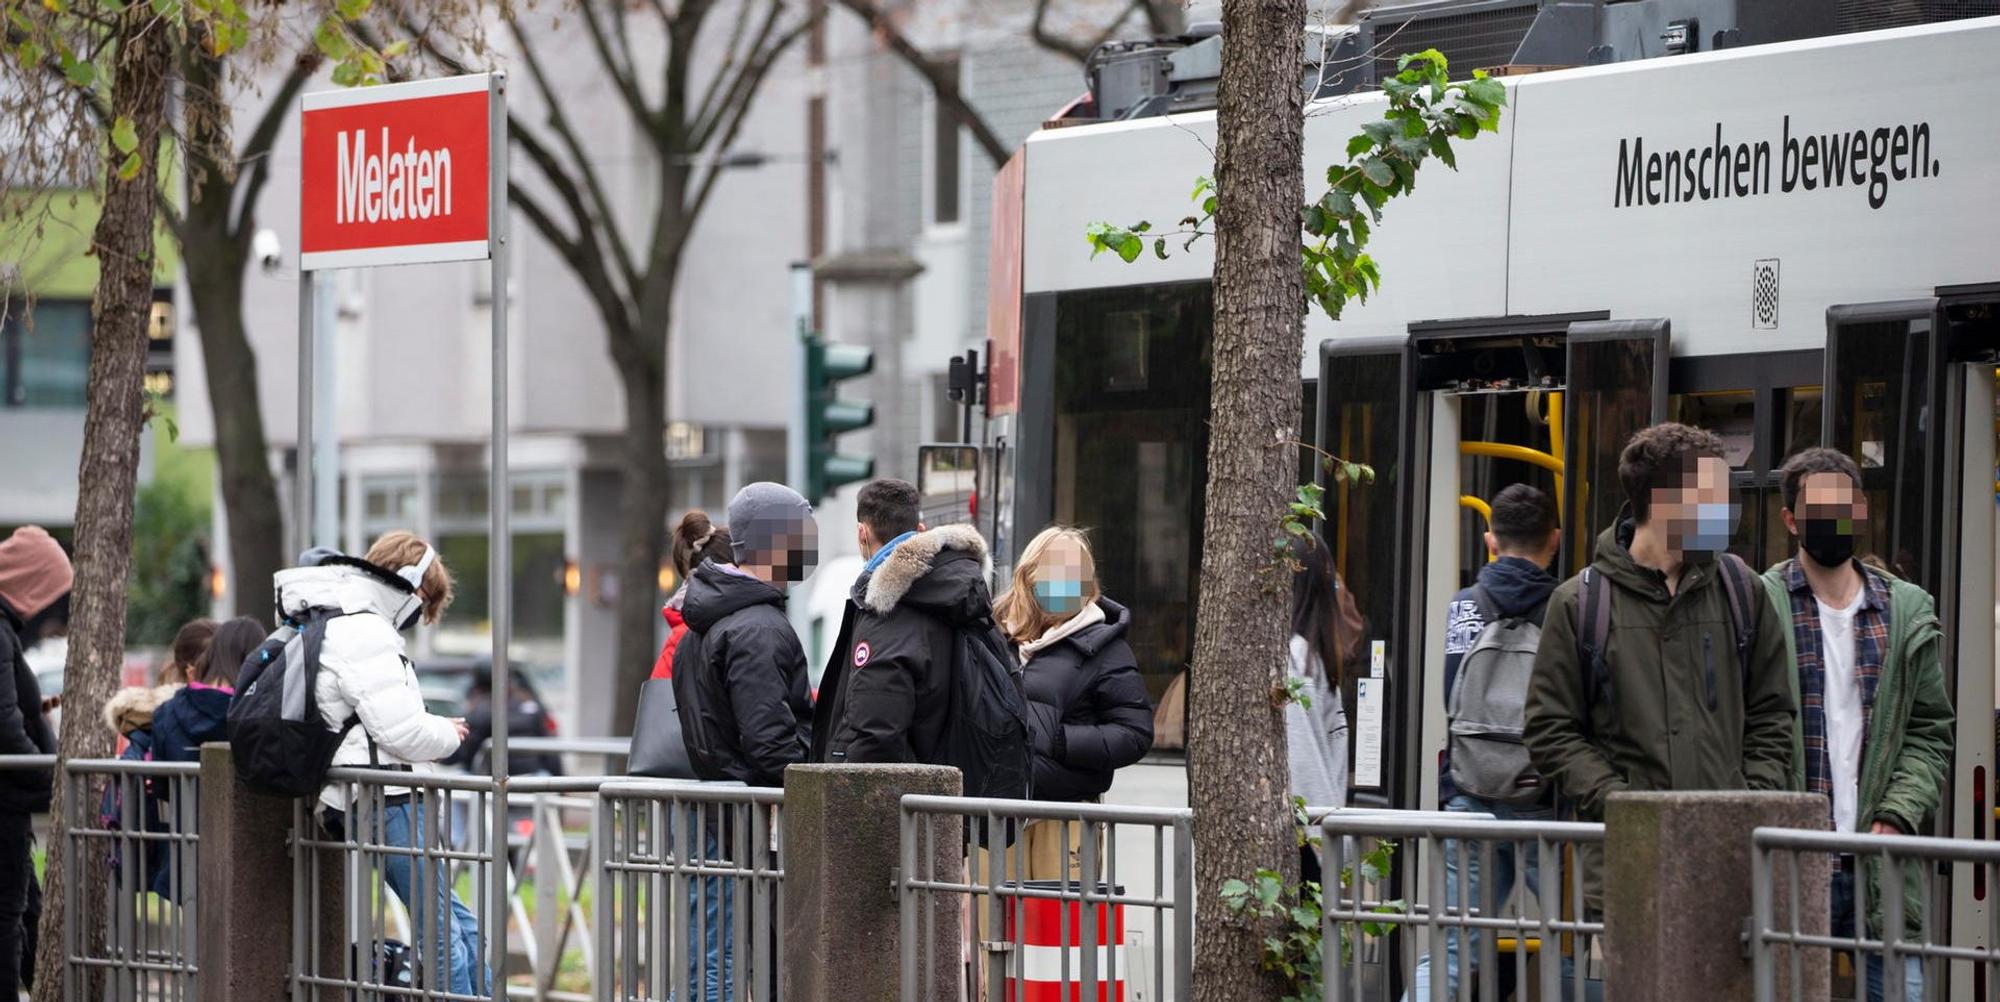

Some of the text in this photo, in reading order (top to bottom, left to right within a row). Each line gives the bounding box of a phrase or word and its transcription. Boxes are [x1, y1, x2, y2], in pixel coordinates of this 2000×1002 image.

[337, 126, 452, 224] Melaten
[1614, 115, 1940, 210] Menschen bewegen.
